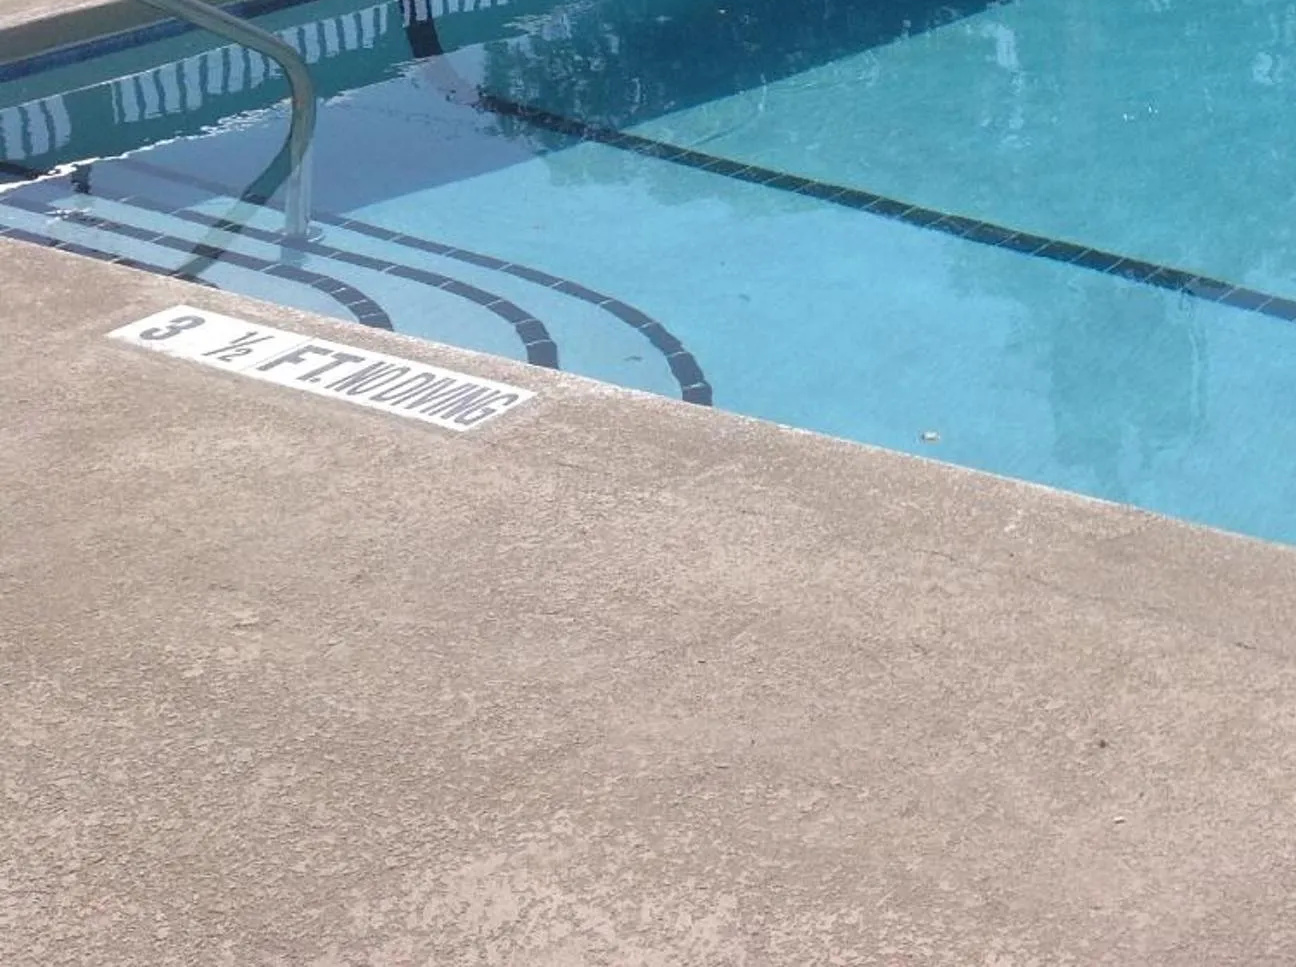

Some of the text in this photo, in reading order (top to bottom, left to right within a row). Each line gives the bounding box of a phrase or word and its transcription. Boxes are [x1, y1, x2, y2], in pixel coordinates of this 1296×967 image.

[139, 315, 206, 340] 3
[324, 361, 411, 396] NO
[369, 372, 519, 426] DIVING
